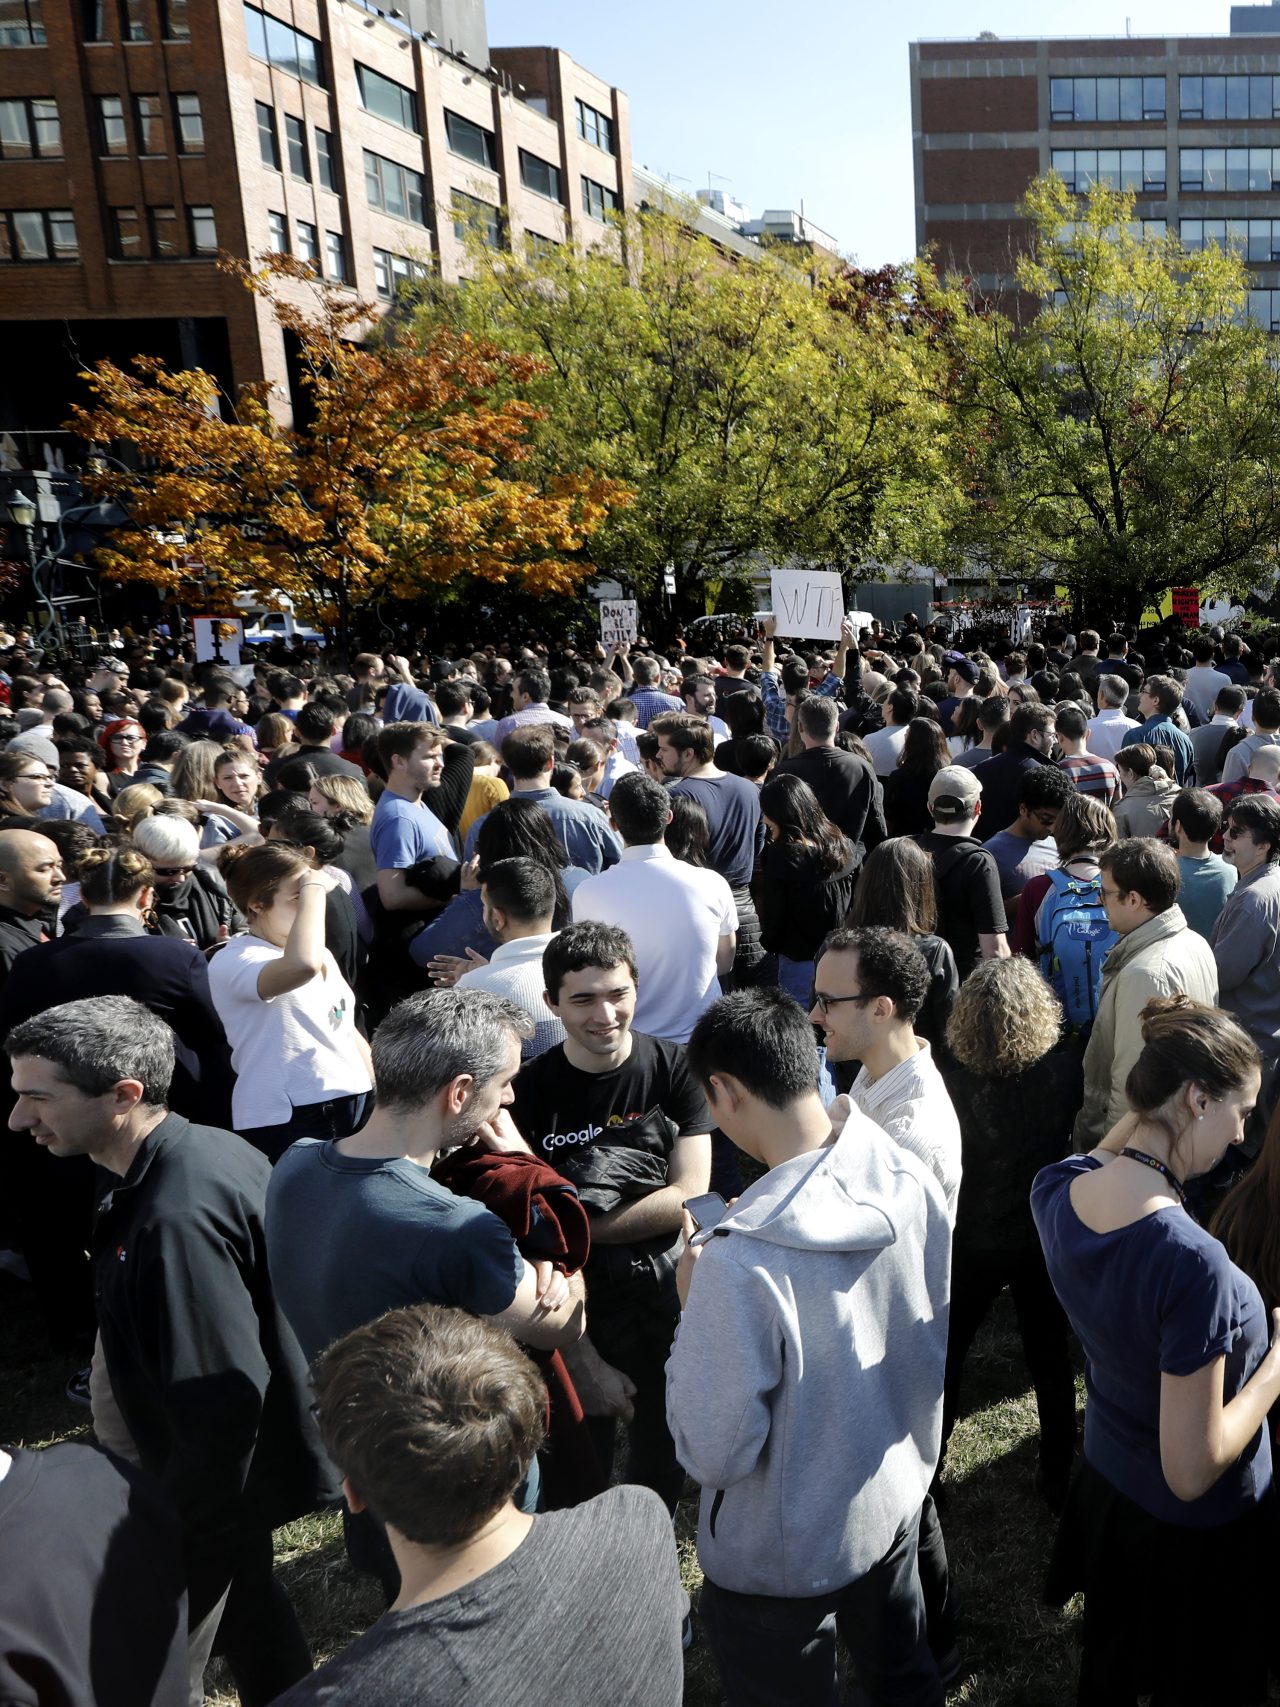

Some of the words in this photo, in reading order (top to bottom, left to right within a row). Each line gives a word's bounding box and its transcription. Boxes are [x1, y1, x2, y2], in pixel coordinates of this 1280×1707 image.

[778, 581, 841, 628] WTF
[1076, 927, 1101, 937] Google
[542, 1123, 604, 1151] Google
